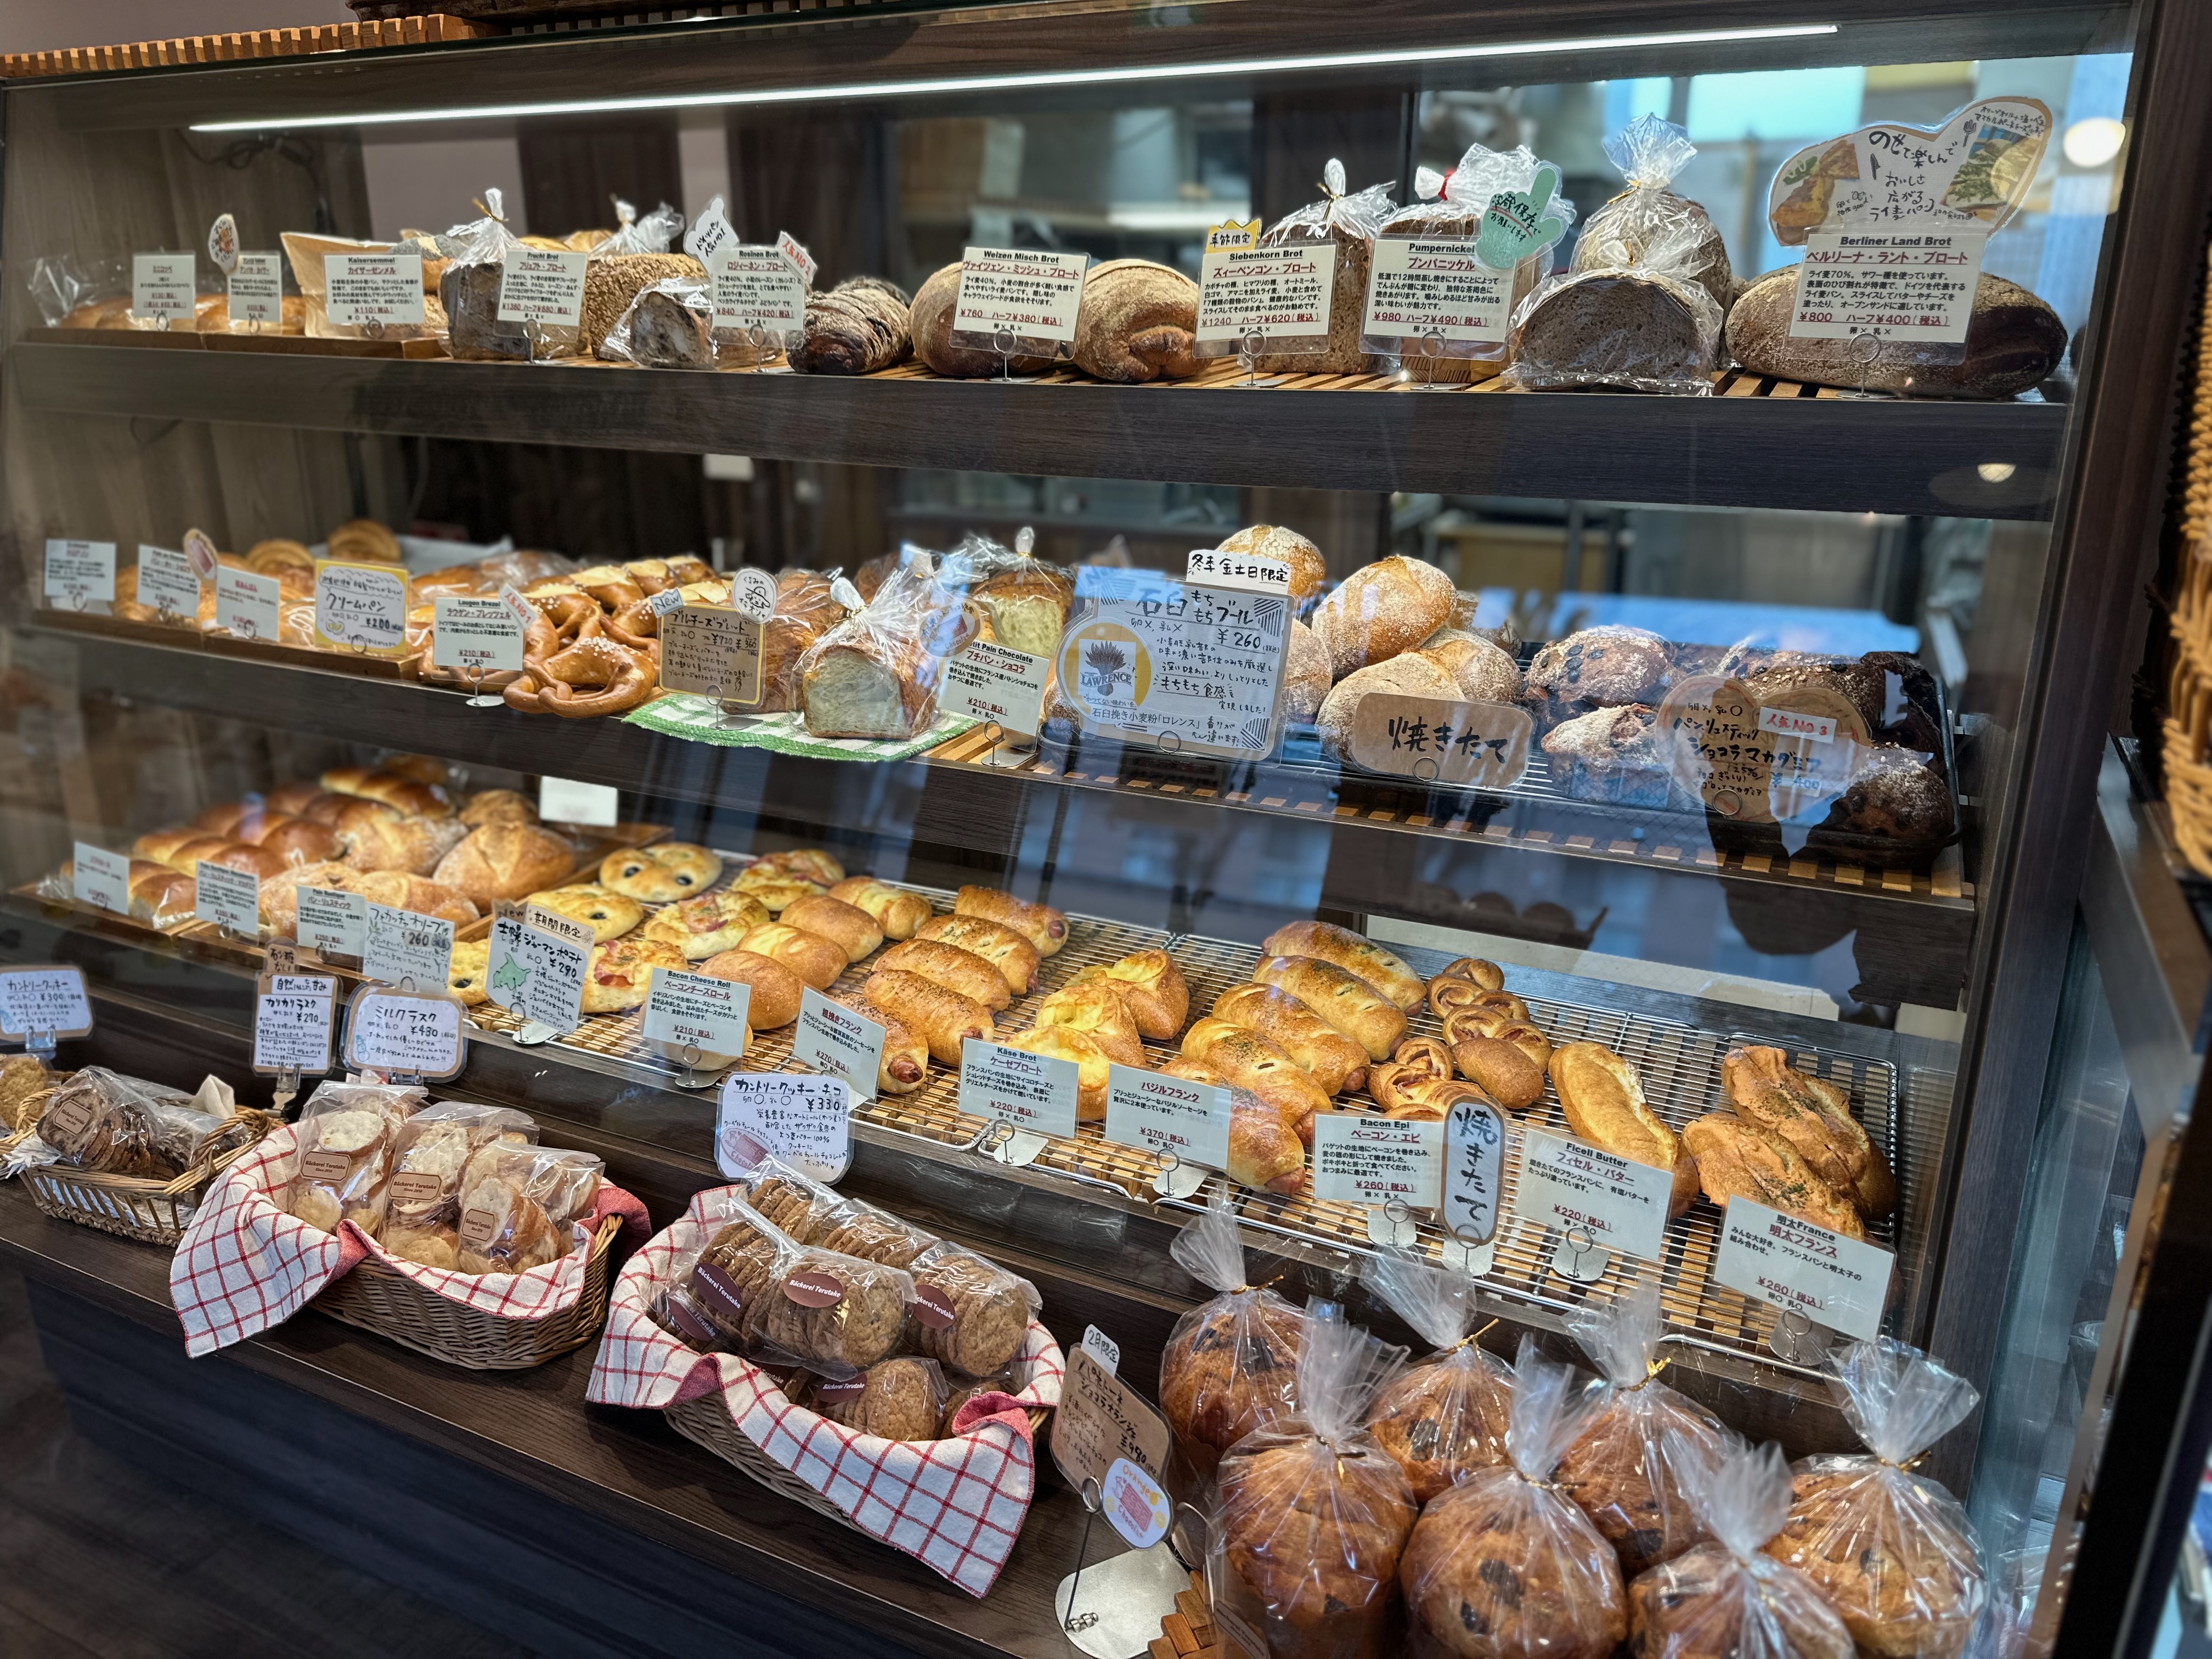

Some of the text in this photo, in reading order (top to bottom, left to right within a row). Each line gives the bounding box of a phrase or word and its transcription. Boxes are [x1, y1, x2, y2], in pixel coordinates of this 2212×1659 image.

[1409, 244, 1475, 253] Pumpernickel
[1841, 236, 1952, 246] Berliner Land Brot
[984, 251, 1059, 263] Weizen Misch Brot
[1229, 251, 1280, 261] Siebenkorn
[654, 595, 679, 610] New
[982, 645, 1033, 663] Pain Chocolate
[1081, 672, 1132, 687] LAWRENCE
[1389, 716, 1508, 764] 焼きたて
[498, 909, 524, 917] New
[668, 970, 689, 980] Bacon
[690, 975, 715, 985] Cheese
[1019, 1052, 1036, 1062] Brot
[1360, 1119, 1409, 1130] Bacon Epi
[1566, 1142, 1628, 1168] Ficell Butter
[1454, 1107, 1498, 1222] 焼きたて
[1769, 1224, 1837, 1257] 明太フランス
[697, 1266, 741, 1309] Bäckerei Terutake
[789, 1279, 841, 1297] Bäckerei Terutake
[933, 1304, 954, 1320] Terutake
[695, 1311, 716, 1337] Terutake
[1122, 1464, 1151, 1497] Orange
